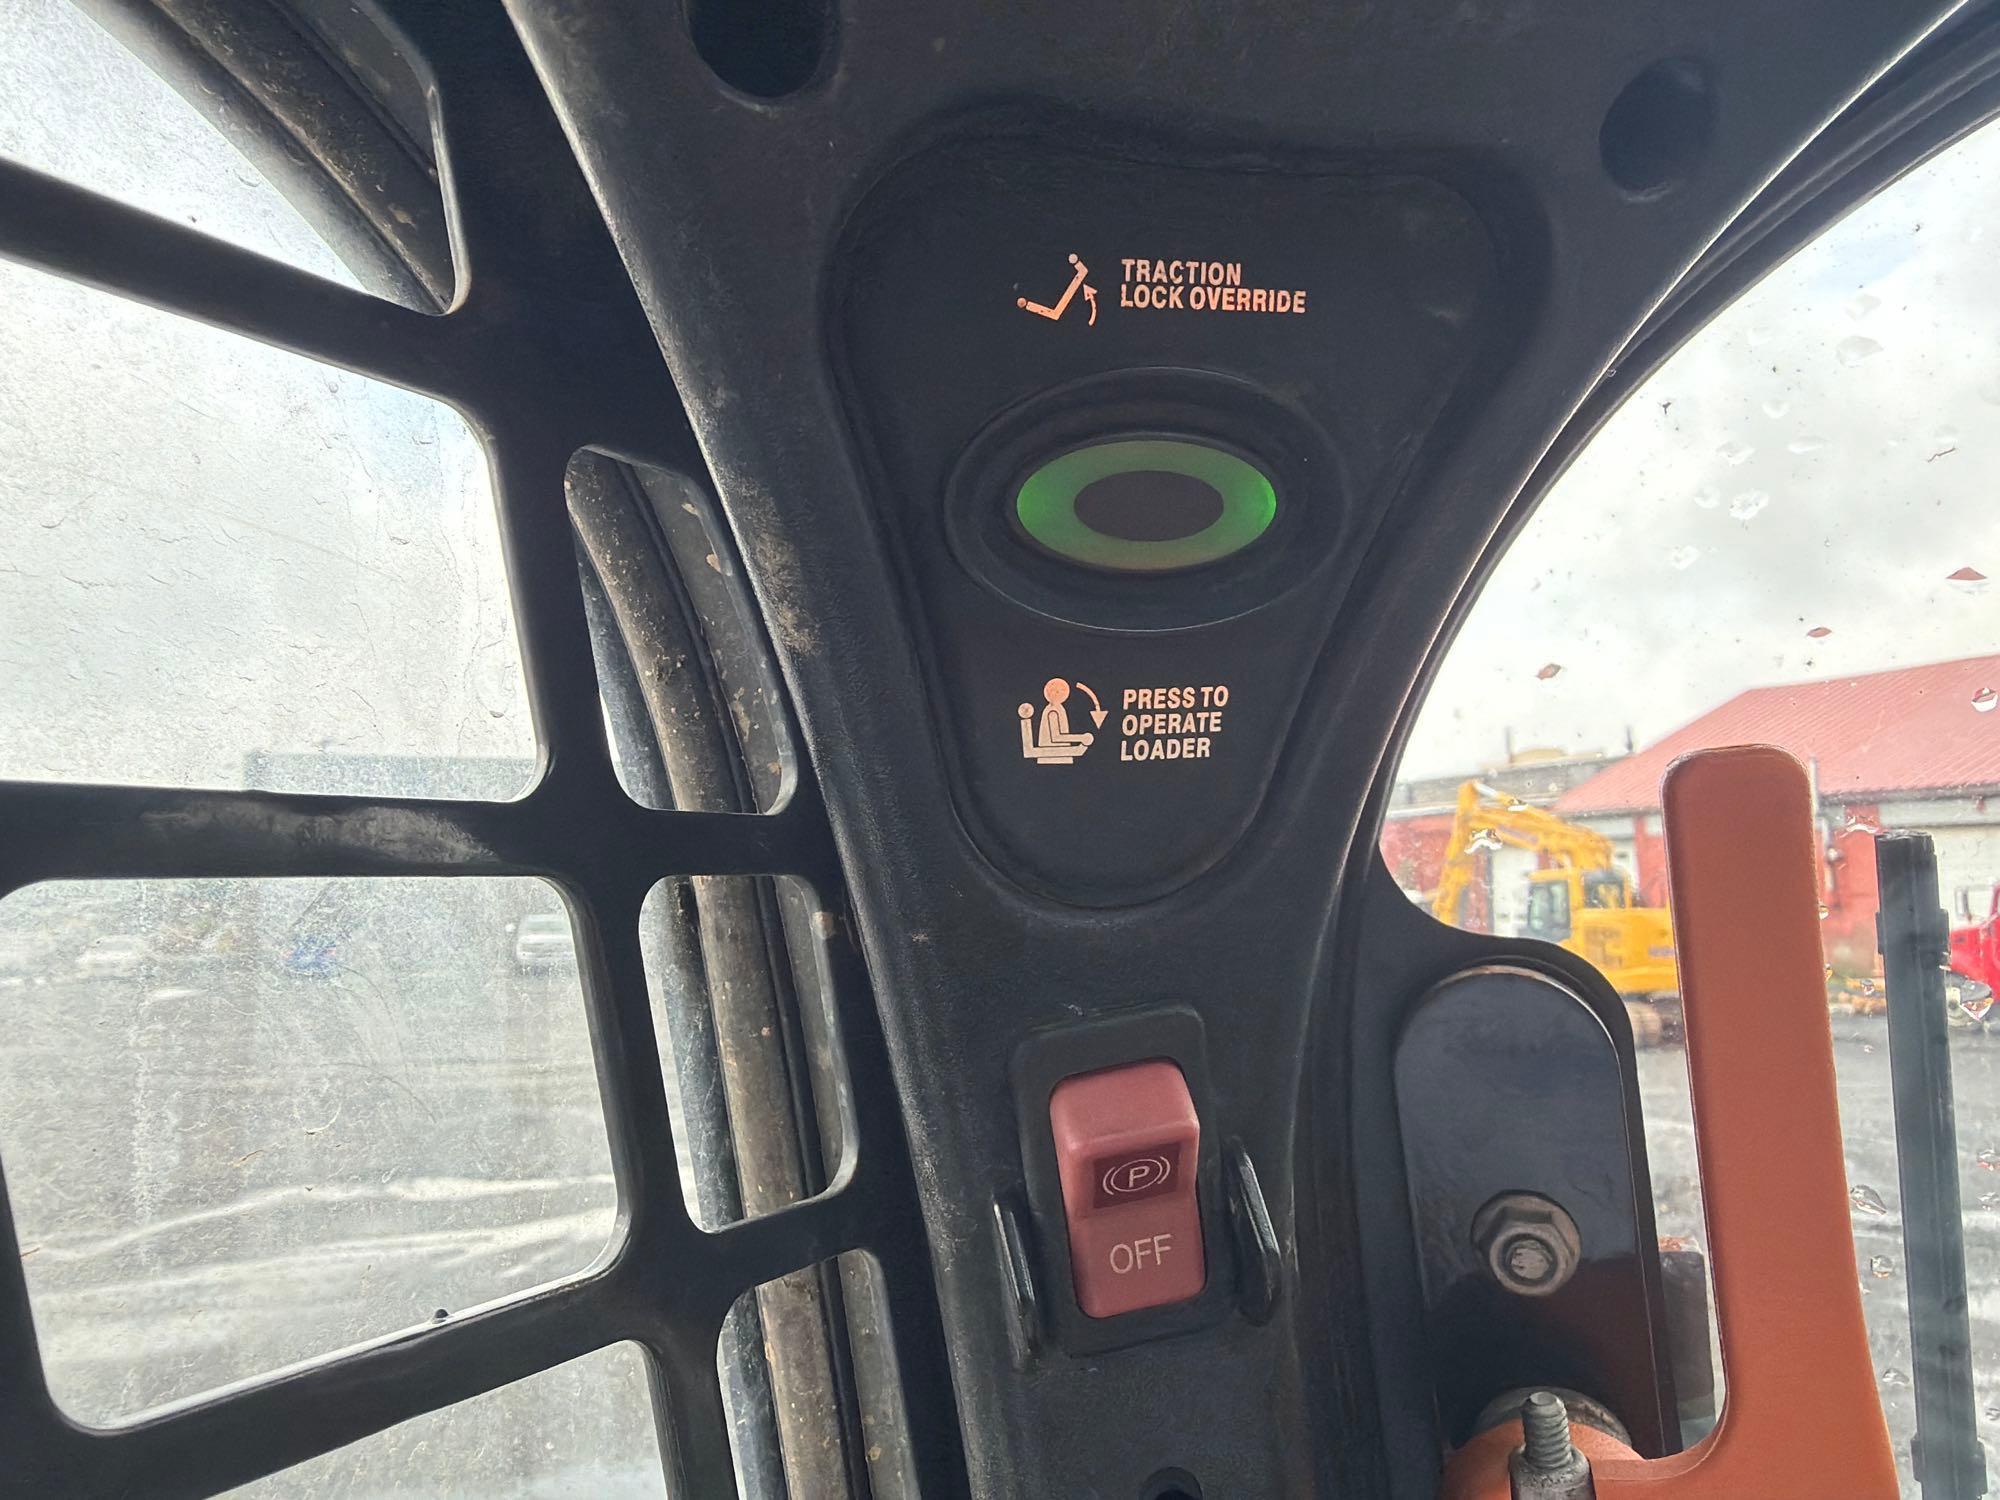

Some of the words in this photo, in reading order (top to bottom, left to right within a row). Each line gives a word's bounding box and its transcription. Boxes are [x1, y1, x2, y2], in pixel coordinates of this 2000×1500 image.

[1121, 258, 1242, 286] TRACTION
[1120, 284, 1186, 309] LOCK
[1189, 286, 1307, 314] OVERRIDE
[1123, 686, 1196, 710] PRESS
[1200, 685, 1229, 708] TO
[1121, 711, 1223, 736] OPERATE
[1120, 737, 1211, 761] LOADER
[1128, 1165, 1150, 1188] P
[1109, 1233, 1172, 1274] OFF
